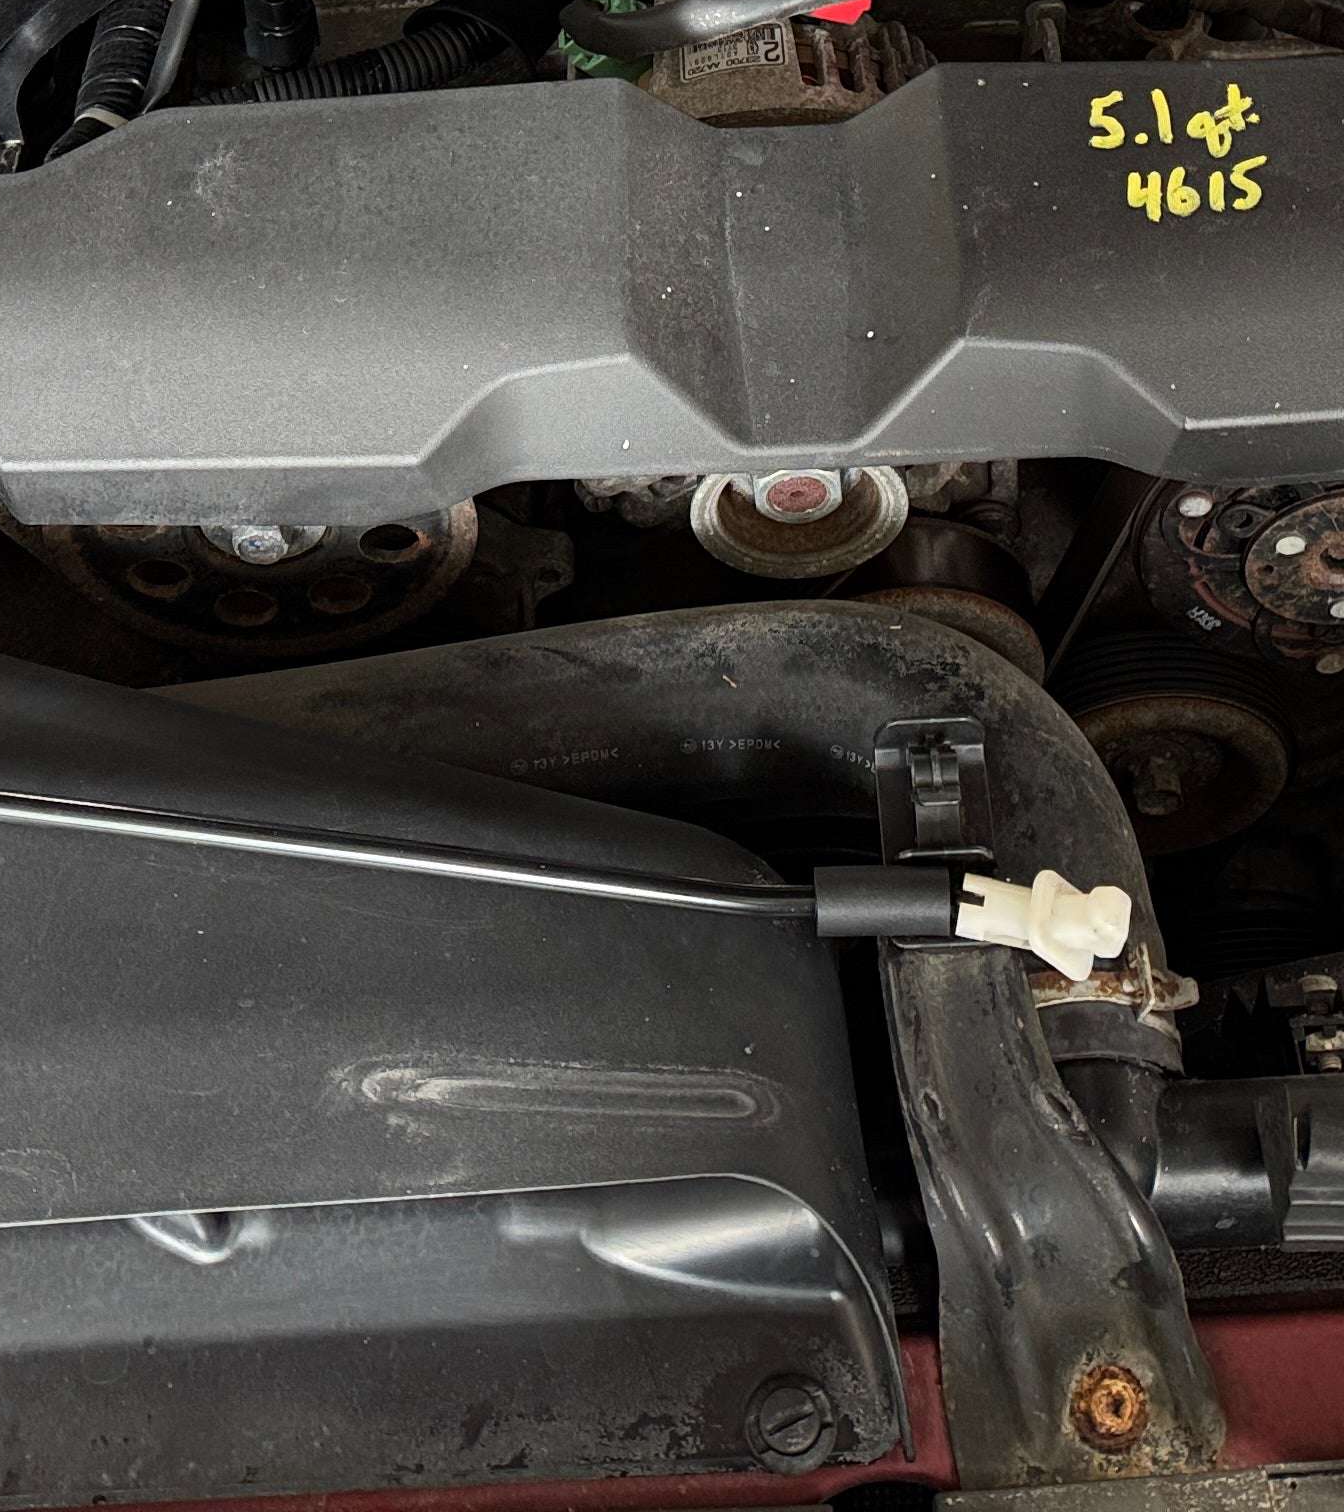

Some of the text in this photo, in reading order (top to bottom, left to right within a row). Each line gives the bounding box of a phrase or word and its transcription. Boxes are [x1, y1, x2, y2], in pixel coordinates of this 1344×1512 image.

[763, 41, 781, 62] 2
[1089, 88, 1173, 149] 5.1
[1127, 155, 1268, 222] 4615
[701, 737, 781, 752] 13Y >EPDM<
